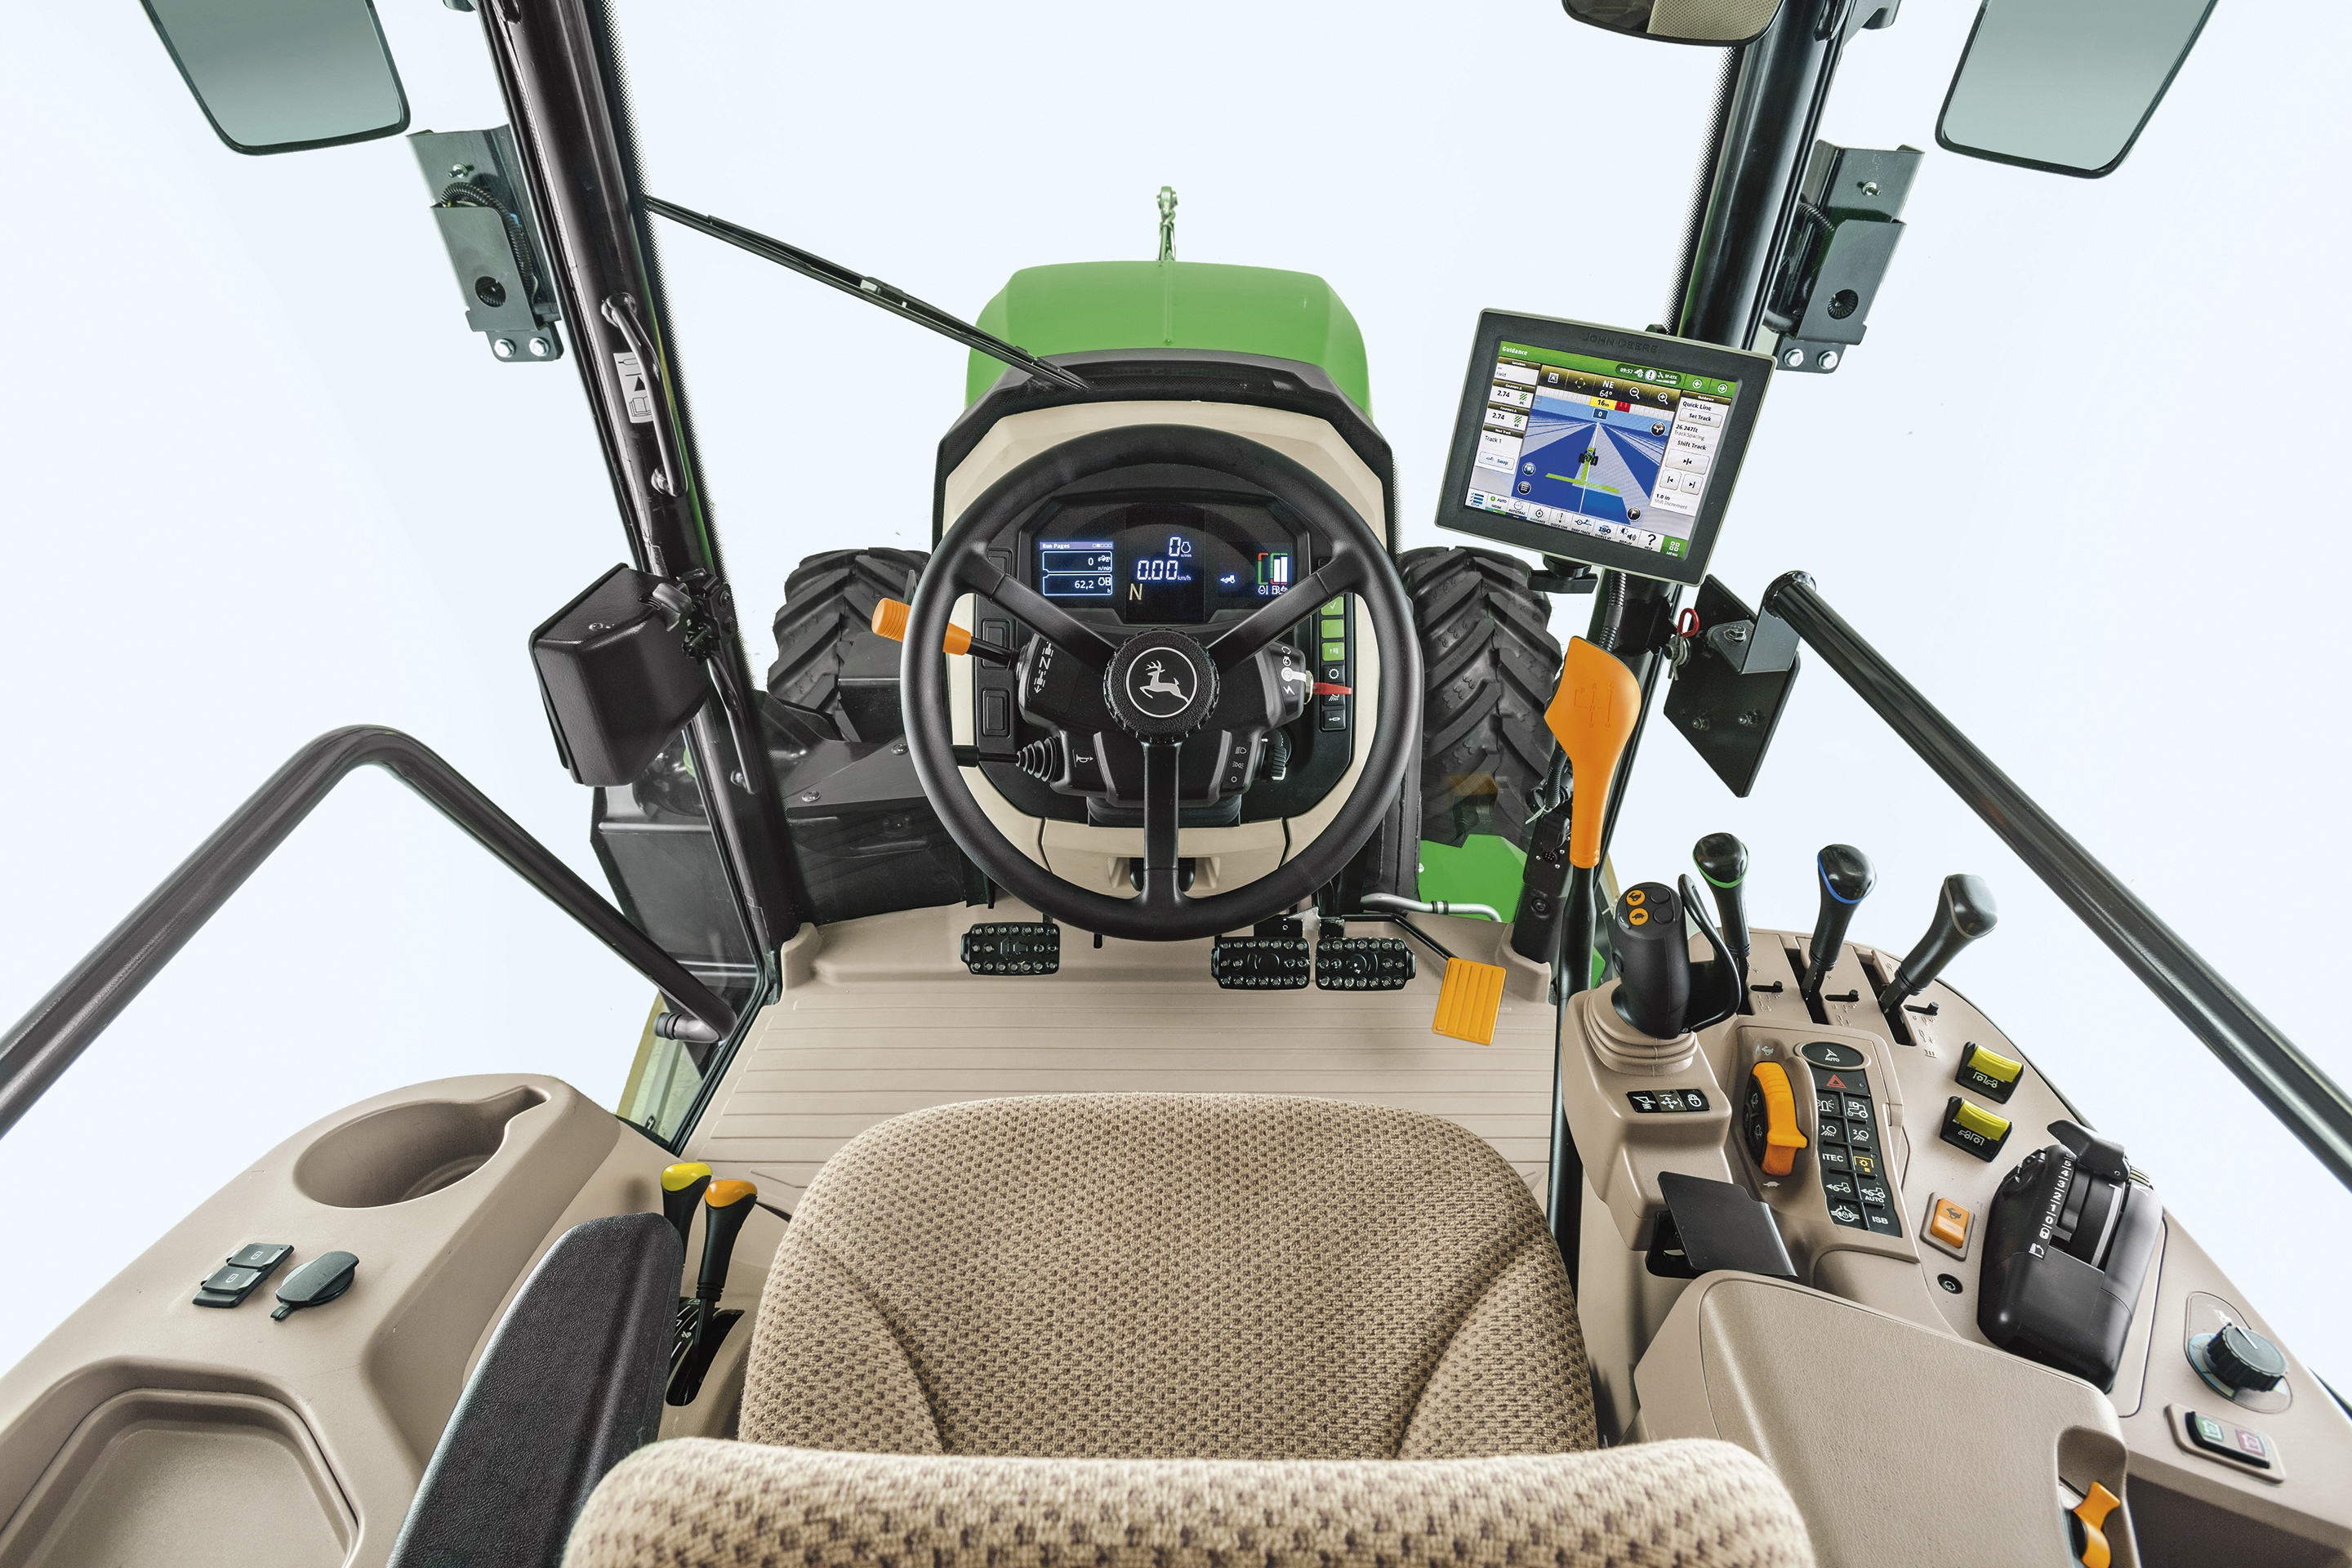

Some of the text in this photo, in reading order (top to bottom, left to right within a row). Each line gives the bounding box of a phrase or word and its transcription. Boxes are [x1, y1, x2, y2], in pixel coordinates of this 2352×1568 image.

[1584, 332, 1659, 354] JOHN DEERE
[1502, 346, 1528, 356] Guidance
[1602, 380, 1615, 389] NE
[1497, 390, 1510, 398] 2.74
[1599, 390, 1613, 399] 64°
[1682, 401, 1699, 409] Quick
[1485, 435, 1498, 443] Track
[1686, 433, 1705, 441] Spacing
[1691, 442, 1707, 451] Track
[1598, 526, 1611, 534] ISO
[1169, 537, 1181, 557] 0
[1088, 557, 1094, 565] 0
[1137, 560, 1178, 581] 0.00
[1074, 580, 1094, 590] 62,2
[1129, 583, 1143, 600] N
[1039, 656, 1051, 670] N
[1822, 1153, 1844, 1162] iTEC
[2057, 1180, 2065, 1188] 3
[2052, 1192, 2062, 1200] 2
[2050, 1204, 2056, 1212] 1
[2045, 1215, 2054, 1224] 0
